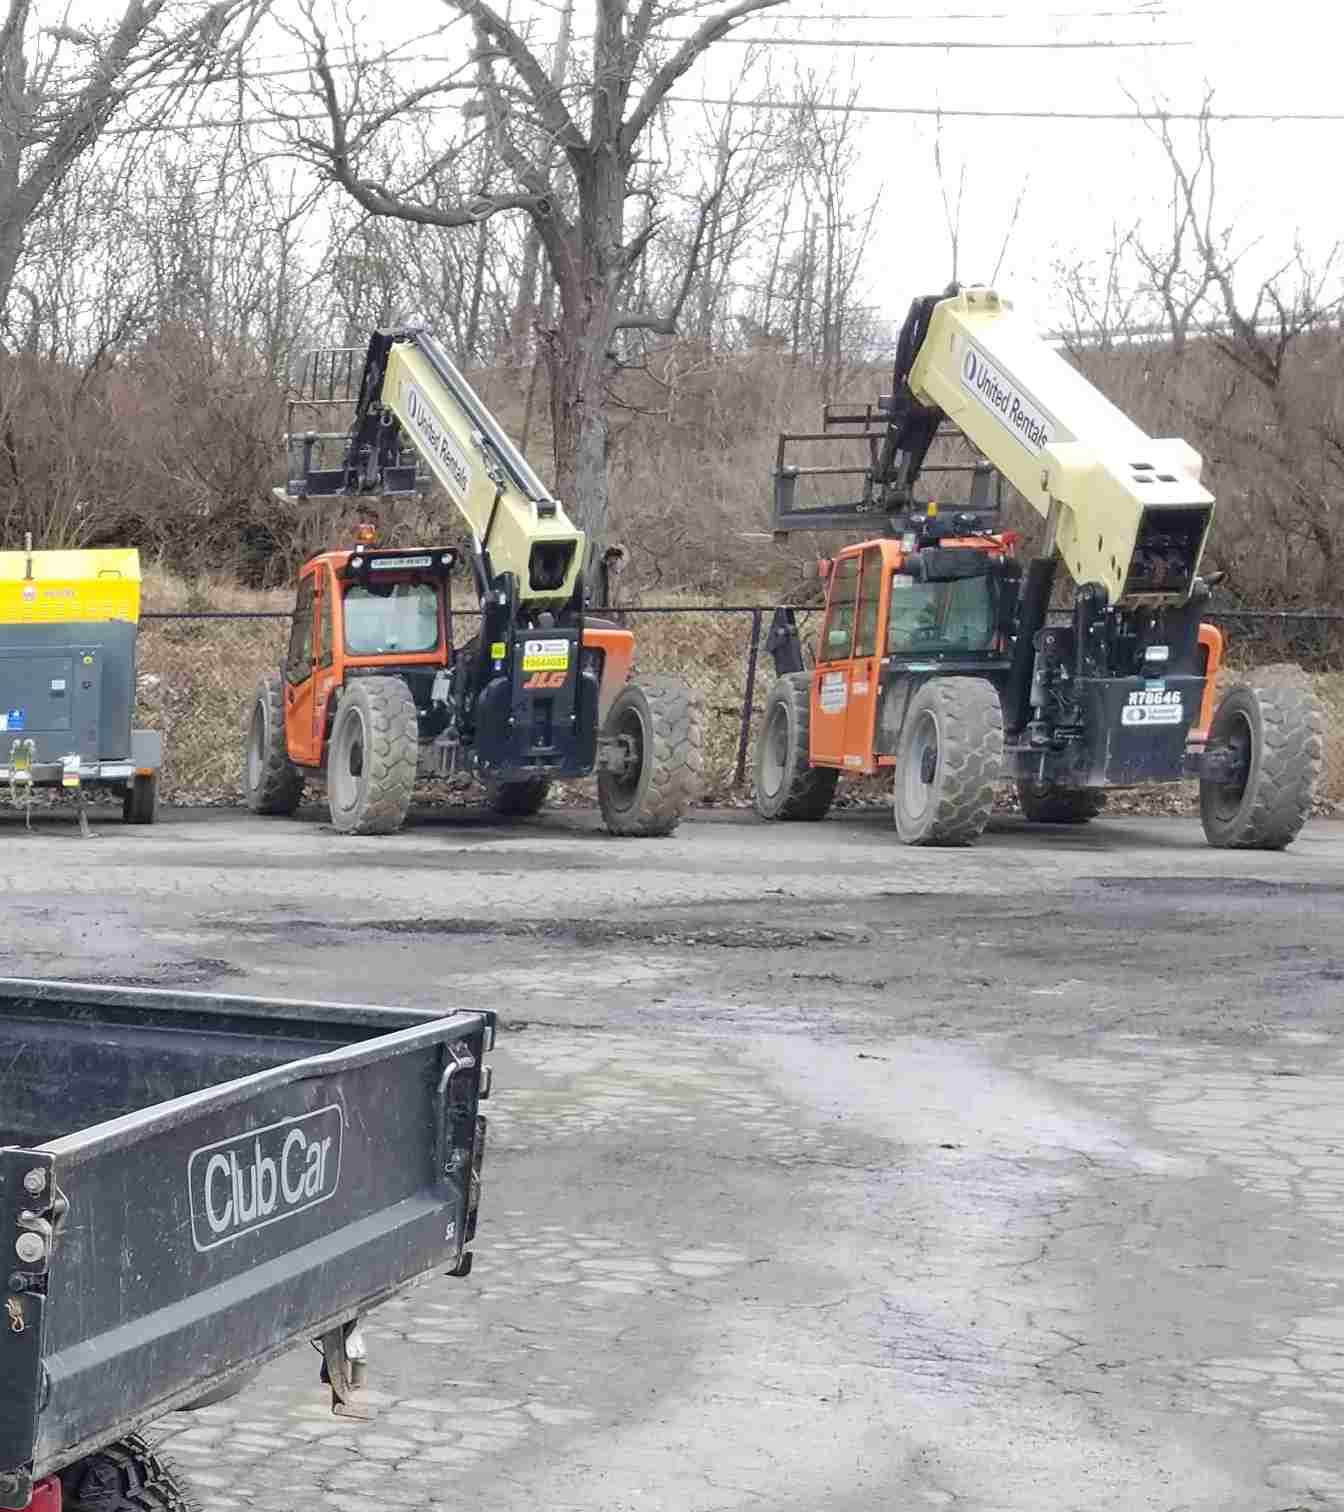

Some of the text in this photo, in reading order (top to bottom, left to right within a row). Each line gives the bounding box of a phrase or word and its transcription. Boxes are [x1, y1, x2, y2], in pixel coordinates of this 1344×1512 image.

[417, 403, 467, 491] United Rentals
[977, 364, 1048, 449] United Rentals
[523, 672, 567, 688] JLG
[205, 1128, 332, 1233] Club Car
